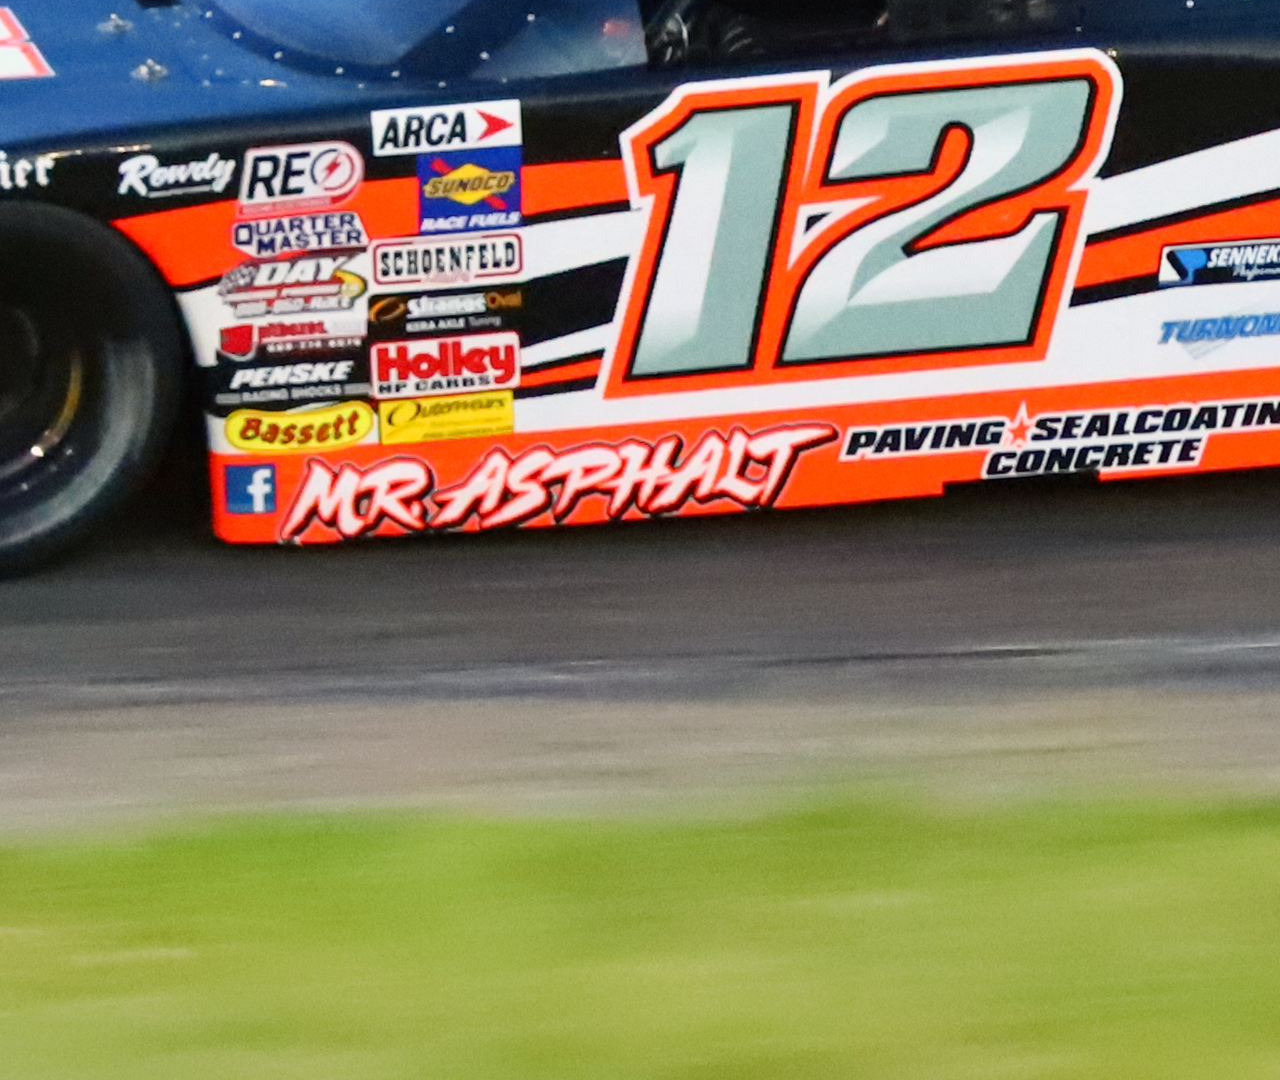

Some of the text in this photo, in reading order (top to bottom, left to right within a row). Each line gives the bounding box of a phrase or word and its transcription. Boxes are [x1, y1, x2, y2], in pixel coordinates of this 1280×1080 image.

[378, 111, 468, 150] ARCA
[118, 152, 236, 199] Rowdy
[423, 170, 516, 198] SUNOCO
[233, 212, 356, 246] QUARTER
[420, 211, 522, 232] RACE FUELS
[612, 58, 1112, 390] 12
[256, 229, 362, 255] MASTER
[379, 240, 516, 277] SCHOENFELD
[252, 256, 348, 287] DAY
[229, 360, 355, 390] PENSKE
[376, 340, 516, 385] Holley
[378, 376, 491, 395] HP CARBS
[238, 410, 361, 445] Bassett
[844, 420, 1007, 456] PAVING
[984, 437, 1203, 477] CONCRETE
